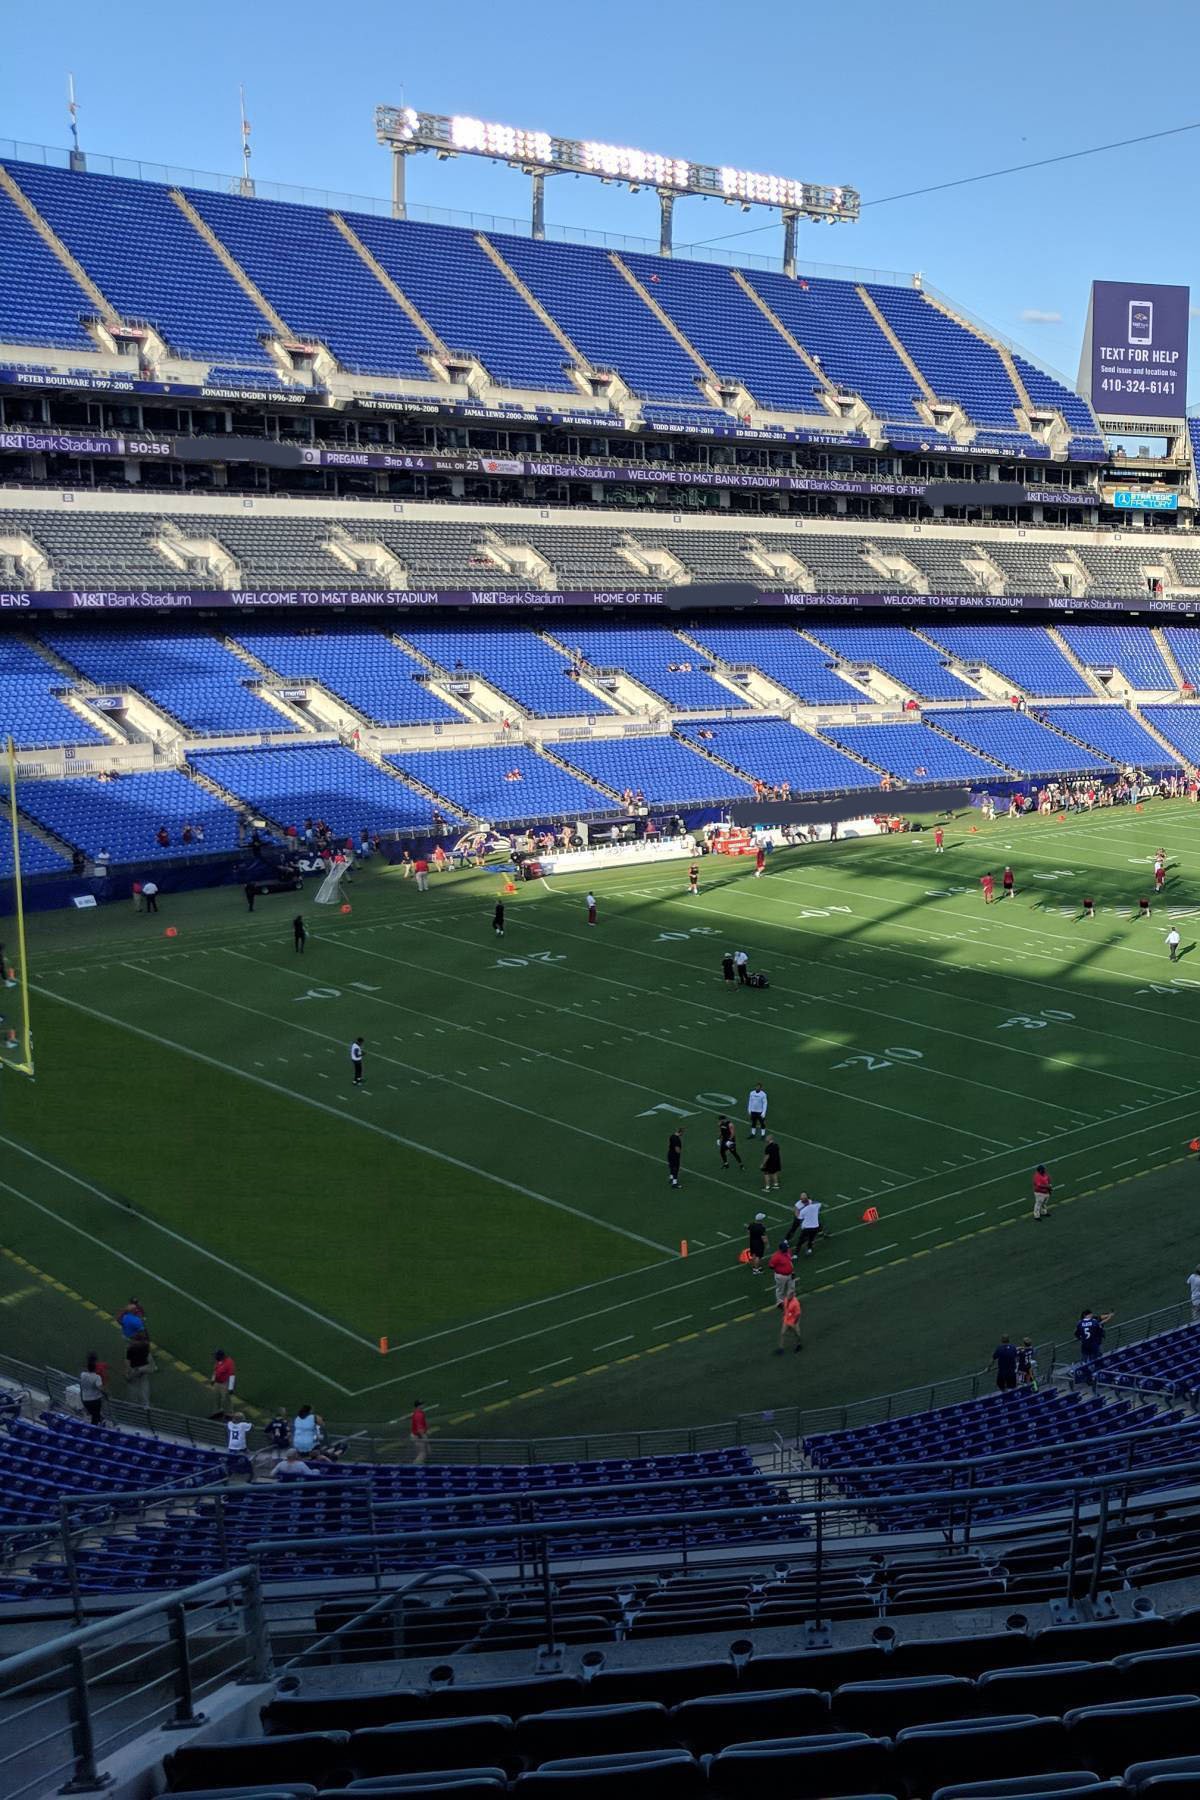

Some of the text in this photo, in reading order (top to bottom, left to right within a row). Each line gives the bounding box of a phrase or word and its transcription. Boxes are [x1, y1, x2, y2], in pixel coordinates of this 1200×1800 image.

[1100, 347, 1179, 363] TEXT FOR HELP
[1101, 365, 1115, 373] Send
[1117, 366, 1132, 374] issue
[1133, 367, 1144, 375] and
[1145, 368, 1169, 377] location
[18, 374, 134, 390] PETER BOULWARE 1997-2005
[1101, 379, 1175, 394] 410-324-6141
[201, 388, 306, 403] JONATHAN OGDEN 1996-2007
[358, 400, 378, 409] MATT
[378, 401, 403, 411] STOVER
[464, 408, 538, 421] JAMAL LEWIS 2000-2006
[562, 416, 574, 424] RAY
[574, 417, 592, 425] LEWIS
[27, 435, 58, 451] Bank
[59, 438, 111, 453] Stadium
[130, 442, 170, 454] 50:56
[327, 453, 369, 465] PREGAME
[384, 456, 424, 467] 3RD & 4
[436, 461, 479, 471] BALL ON 25
[530, 463, 554, 476] M&T
[555, 464, 578, 477] Bank
[578, 467, 616, 479] Stadium
[628, 470, 780, 488] WELCOME TO M&T BANK STADIUM
[810, 480, 830, 491] Bank
[830, 480, 862, 492] Stadium
[870, 484, 895, 494] HOME
[897, 485, 908, 494] OF
[1042, 493, 1063, 503] Bank
[1062, 493, 1095, 504] Stadium
[1131, 493, 1172, 501] STRATEGIC
[1131, 500, 1171, 508] FACTORY
[72, 592, 192, 607] M&T Bank Stadium
[232, 592, 438, 605] WELCOME TO M&T BANK STADIUM
[471, 592, 564, 604] M&T Bank Stadium
[593, 593, 663, 604] HOME OF THE
[784, 594, 858, 604] M&T Bank Stadium
[883, 596, 1023, 606] WELCOME TO M&T BANK STADIUM
[1070, 599, 1089, 608] Bank
[1089, 599, 1124, 609] Stadium
[1150, 601, 1176, 611] HOME
[1178, 602, 1191, 611] OF
[1007, 1009, 1075, 1029] 30
[844, 1047, 923, 1070] 20
[651, 1092, 737, 1118] 10
[1084, 1327, 1091, 1339] 5
